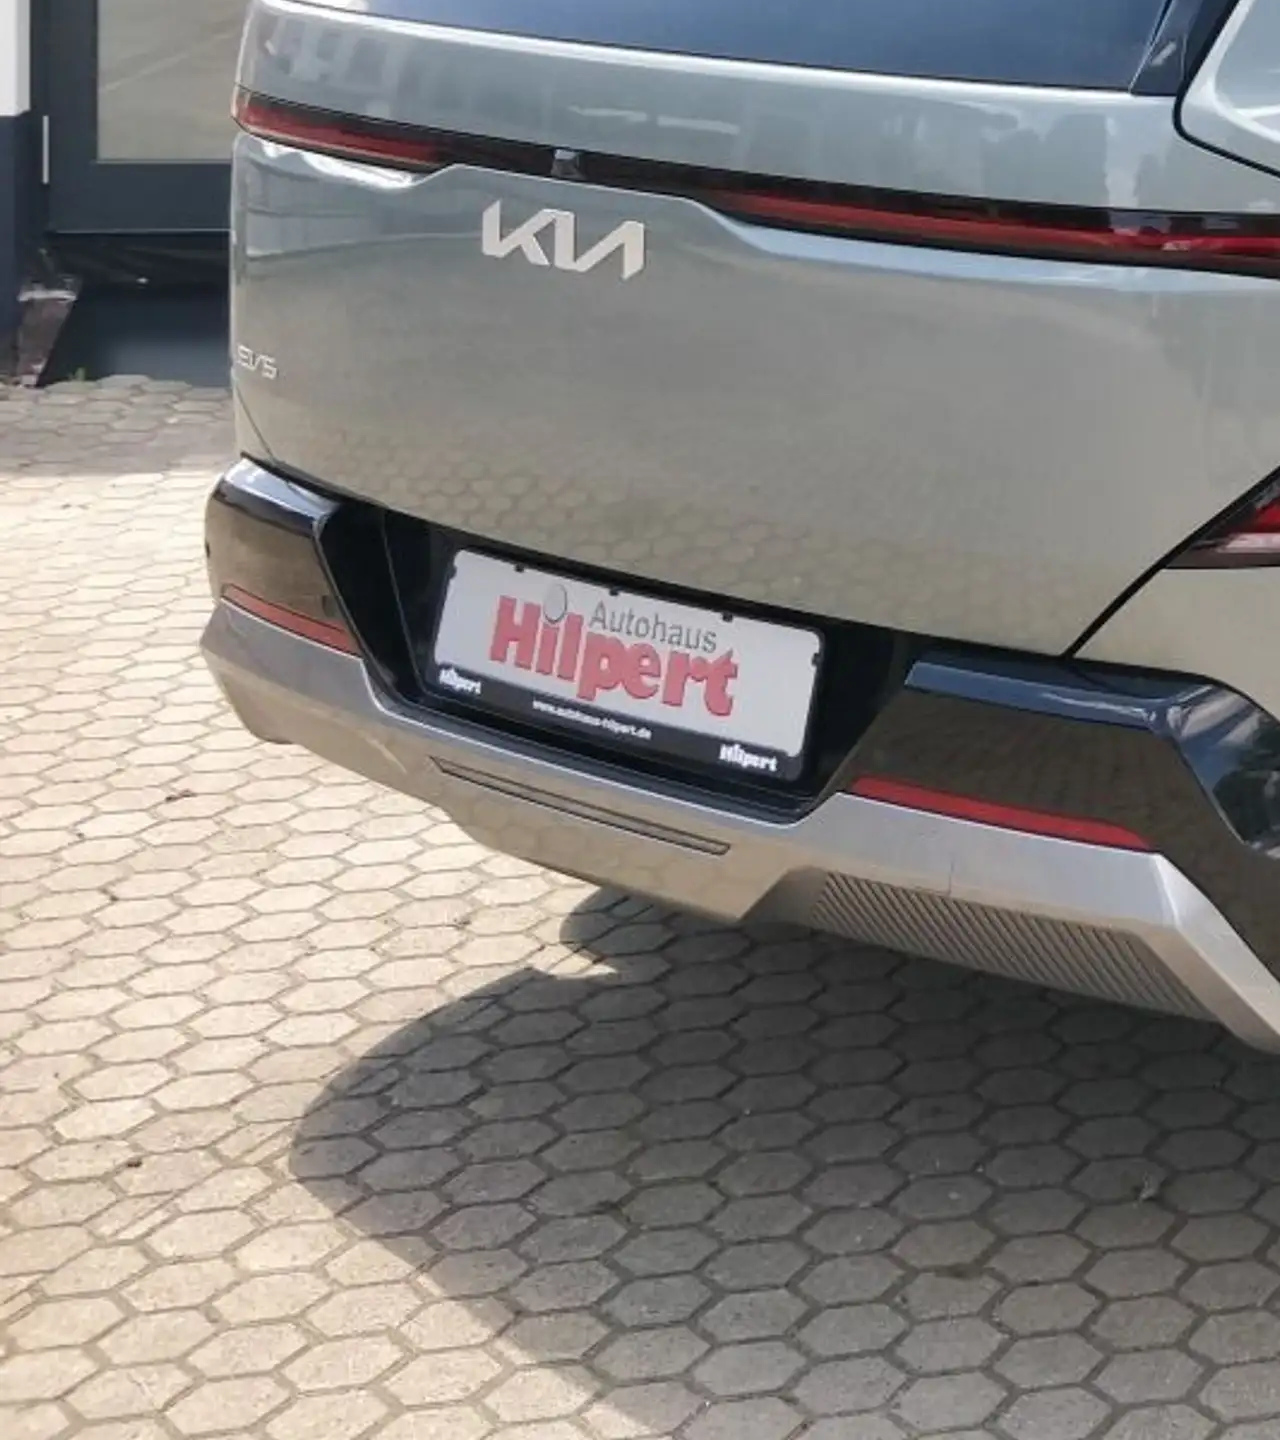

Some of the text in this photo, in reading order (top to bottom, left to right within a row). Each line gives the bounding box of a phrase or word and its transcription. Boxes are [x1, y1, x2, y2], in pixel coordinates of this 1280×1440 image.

[482, 197, 645, 280] KIA
[490, 594, 739, 717] Hilpert
[588, 601, 717, 653] Autohaus
[719, 743, 777, 772] Hilpert
